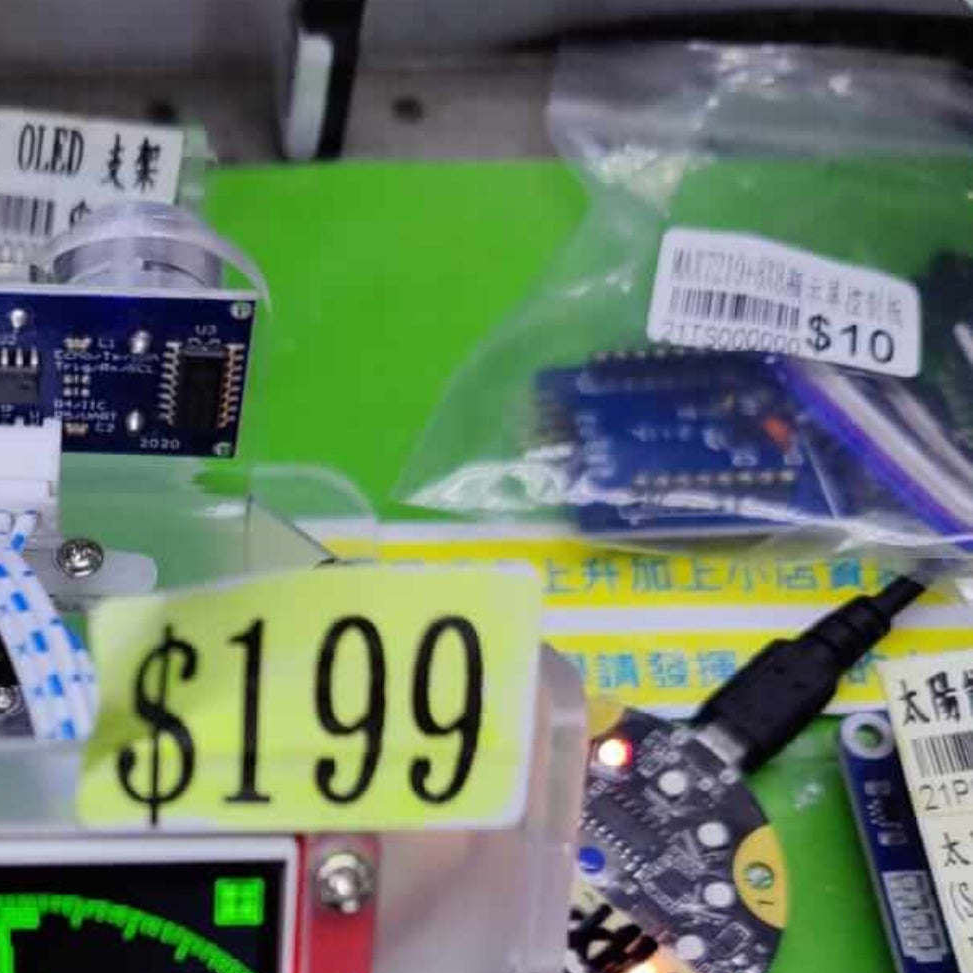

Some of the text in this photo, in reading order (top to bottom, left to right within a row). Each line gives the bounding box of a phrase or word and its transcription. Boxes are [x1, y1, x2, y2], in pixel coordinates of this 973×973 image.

[17, 124, 85, 176] OLED
[101, 133, 161, 192] 支架
[807, 313, 895, 363] $10
[140, 438, 180, 450] 2020
[116, 614, 484, 827] $199
[918, 778, 973, 812] 21P
